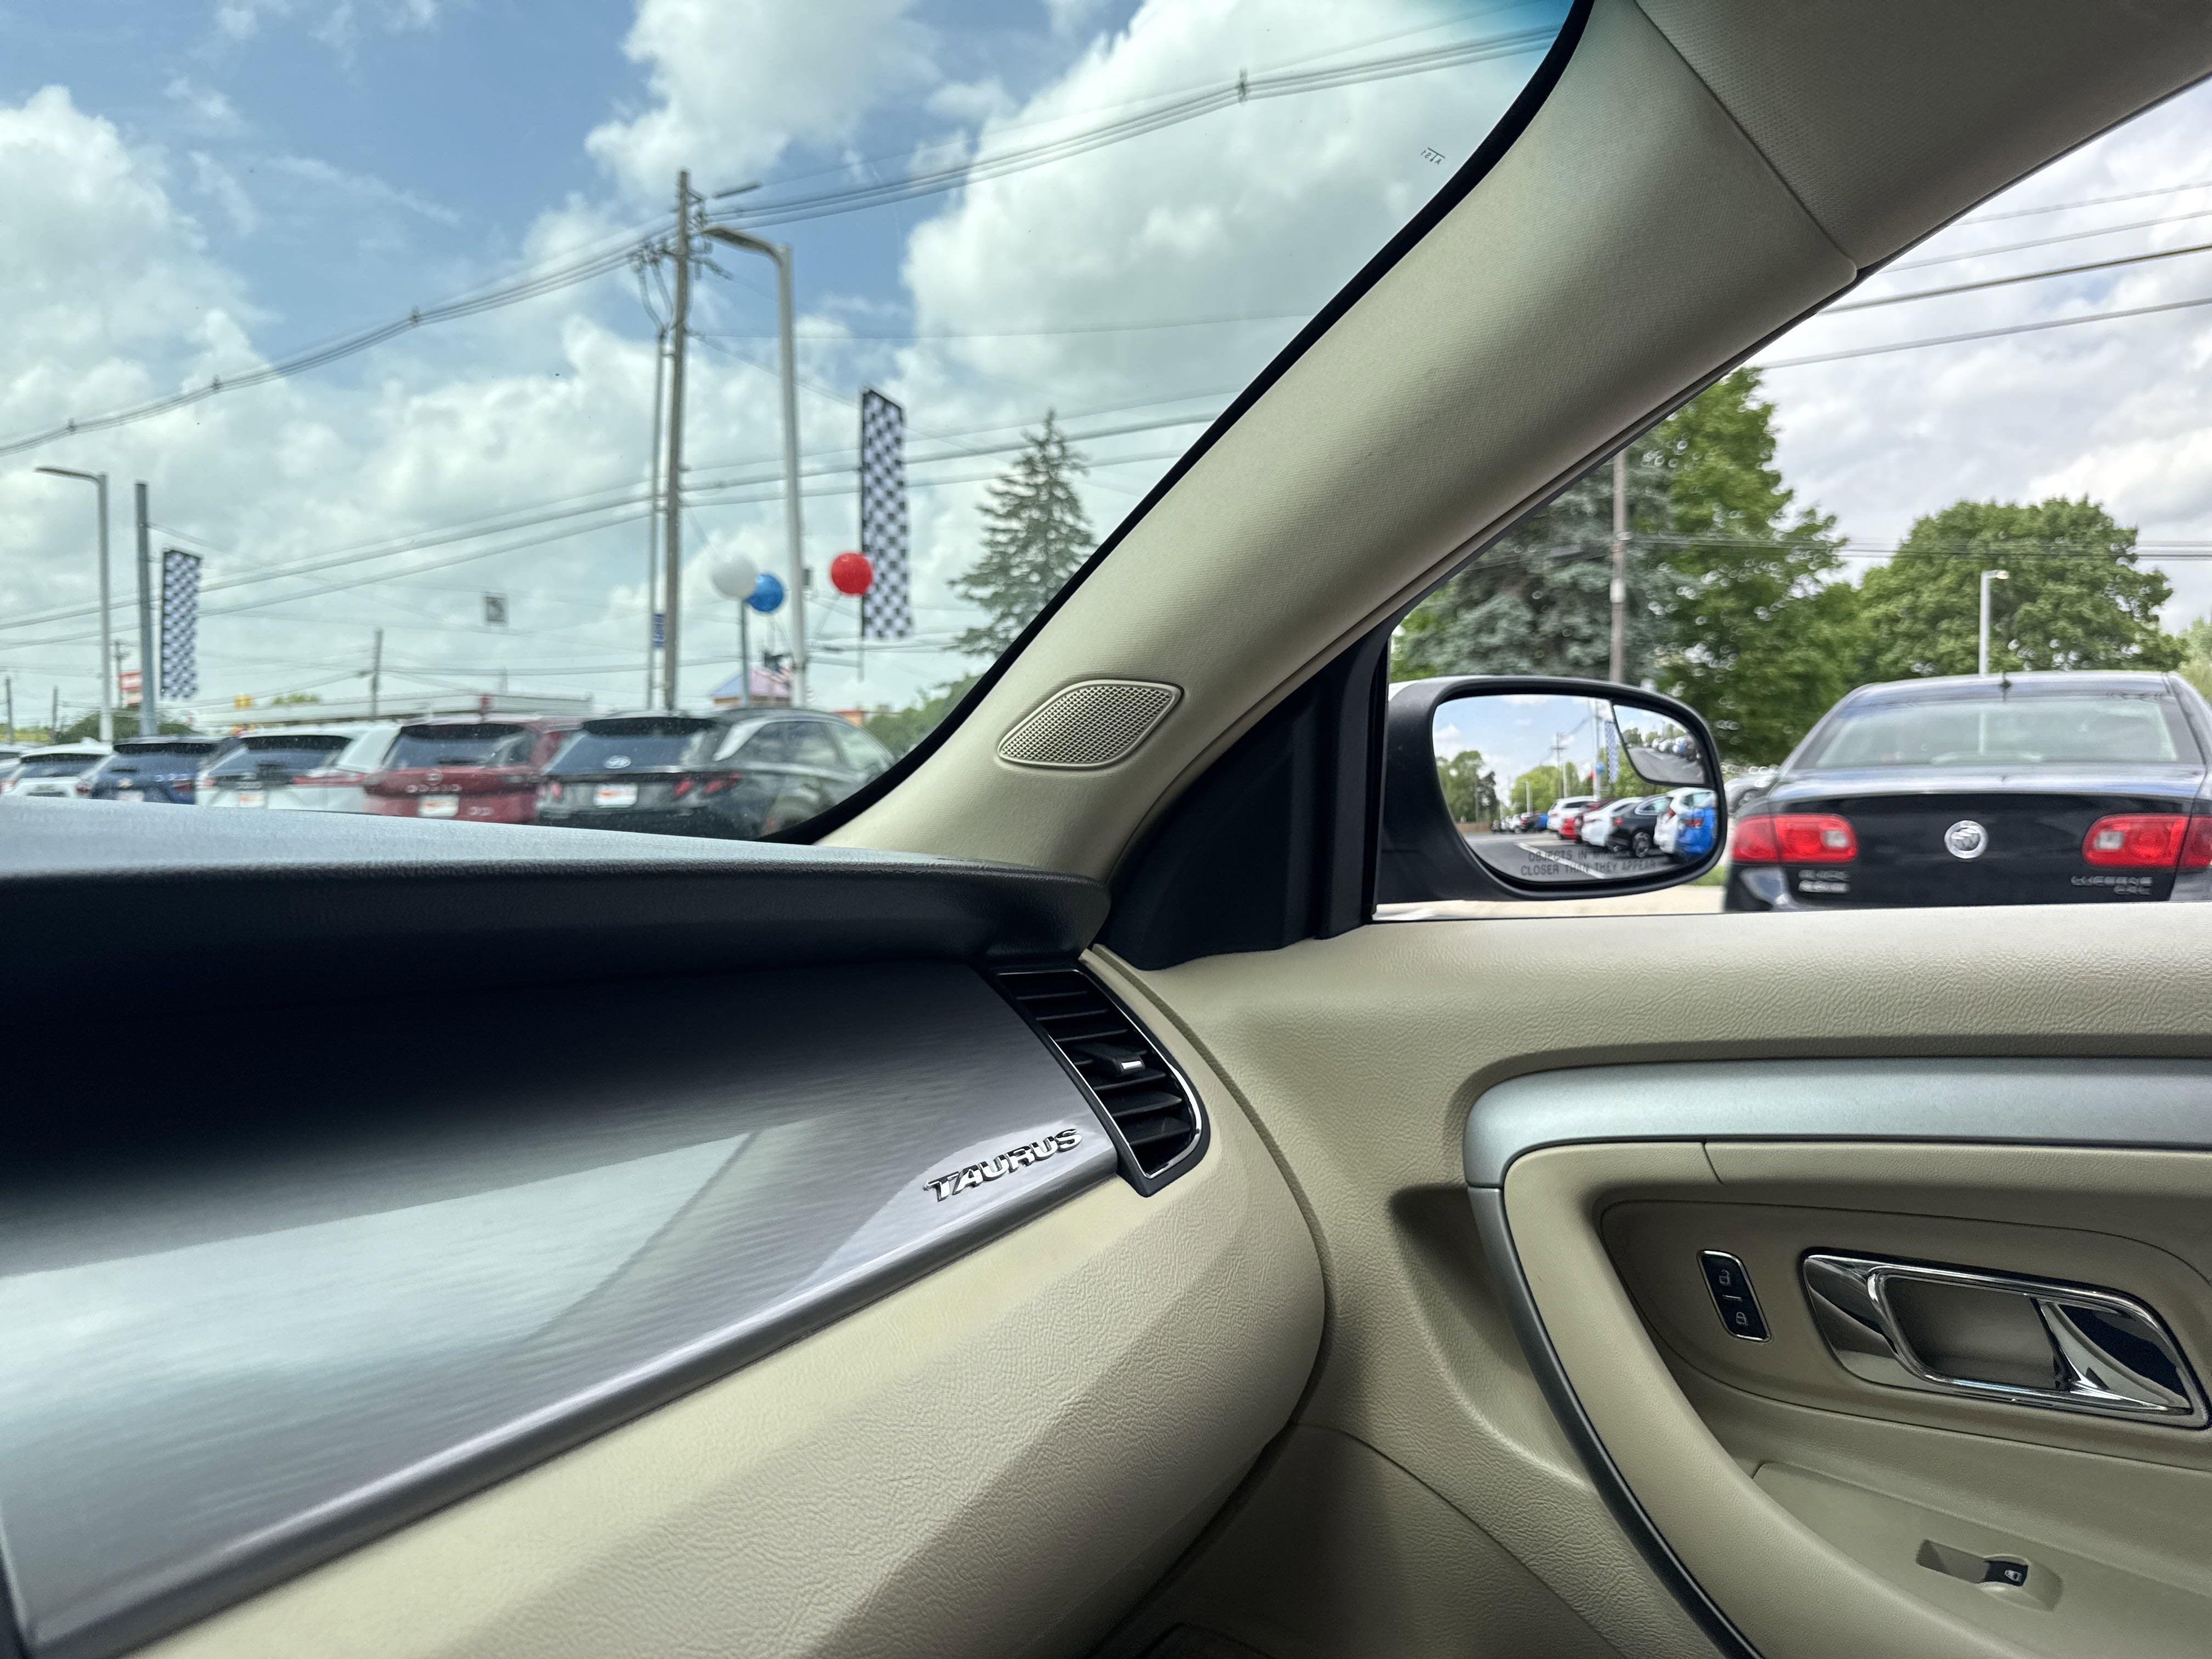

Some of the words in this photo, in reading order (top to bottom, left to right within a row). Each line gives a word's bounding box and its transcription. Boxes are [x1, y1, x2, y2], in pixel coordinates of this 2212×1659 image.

[1528, 850, 1572, 862] OBJECTS
[1520, 864, 1560, 876] CLOSER
[923, 1128, 1083, 1202] TAURUS
